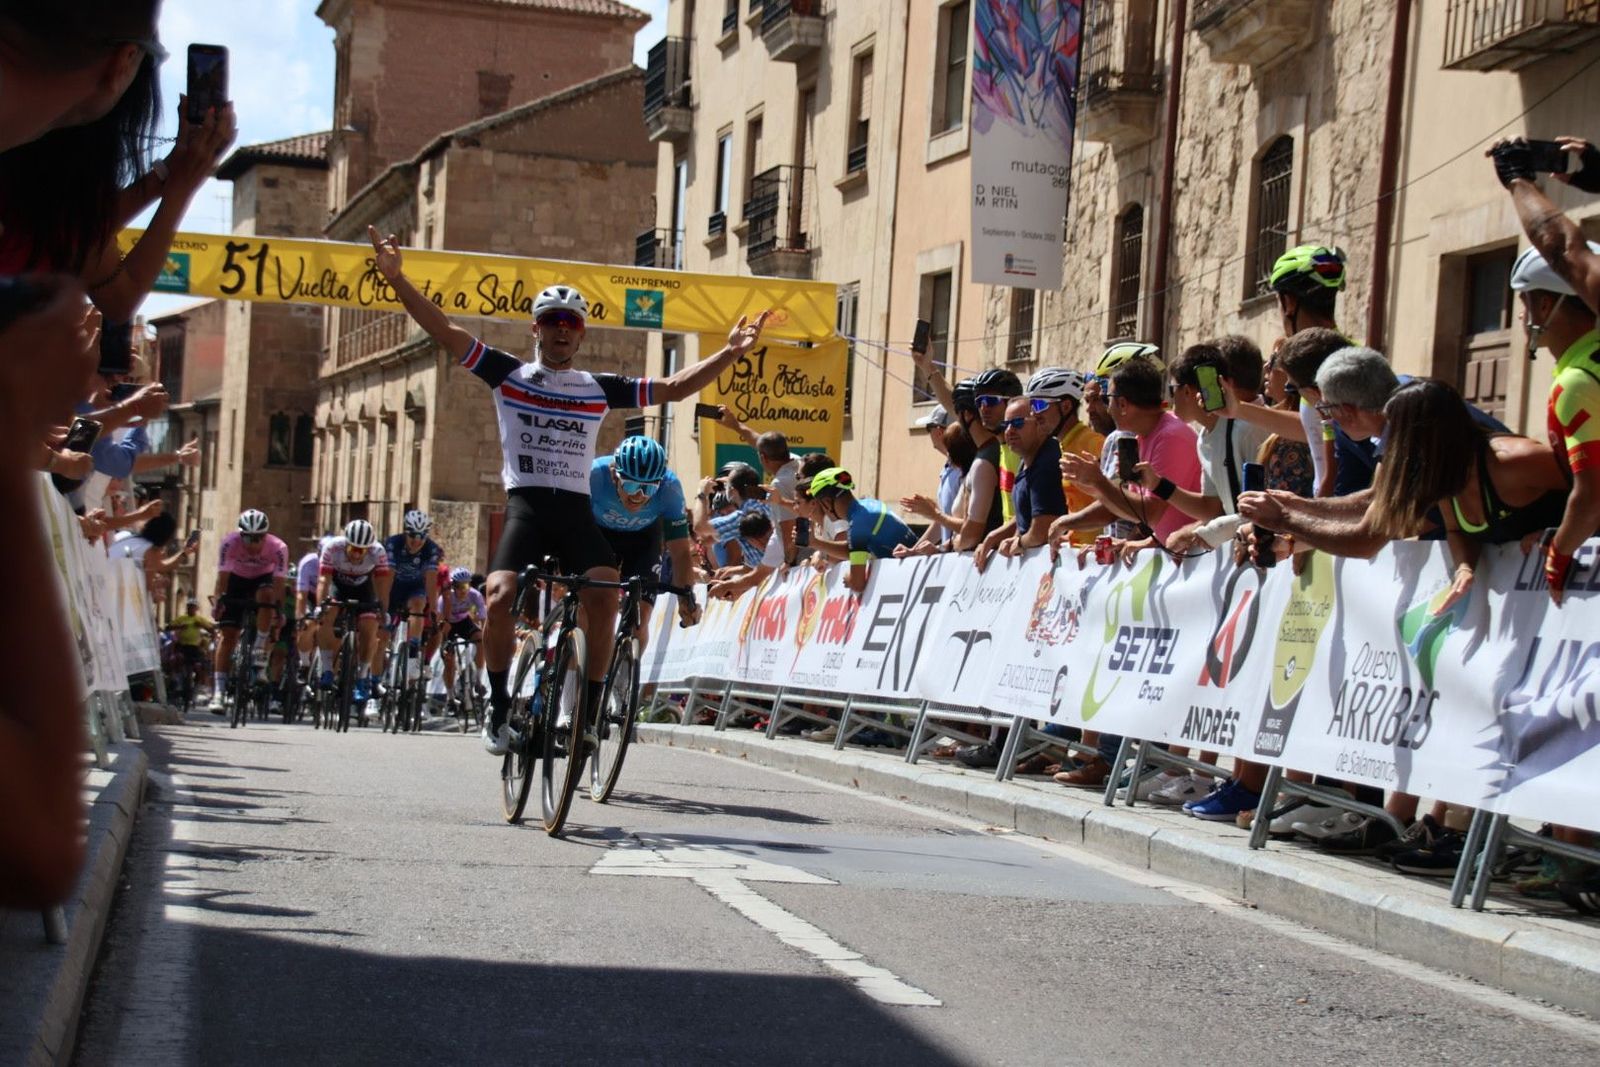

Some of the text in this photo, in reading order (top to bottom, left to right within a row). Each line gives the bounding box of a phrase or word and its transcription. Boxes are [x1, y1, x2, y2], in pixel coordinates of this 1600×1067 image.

[173, 241, 208, 251] REMIO
[220, 240, 269, 296] 51
[275, 255, 355, 301] Vuelta
[357, 267, 445, 308] Cicta
[476, 273, 608, 320] Salaa
[610, 275, 681, 290] GRAN PREMIO
[717, 363, 836, 398] Vuelta Ciclista
[735, 392, 831, 423] Salamanca
[534, 415, 588, 434] LASAL
[538, 434, 587, 451] Porriño
[536, 458, 569, 469] XUNTA
[536, 466, 585, 479] DE GALICIA
[1108, 625, 1180, 675] SETEL
[1352, 641, 1398, 684] Queso
[1138, 679, 1164, 705] Grupo
[1180, 705, 1240, 747] ANDRÉS
[1326, 679, 1440, 750] ARRIBES
[1335, 751, 1348, 772] de
